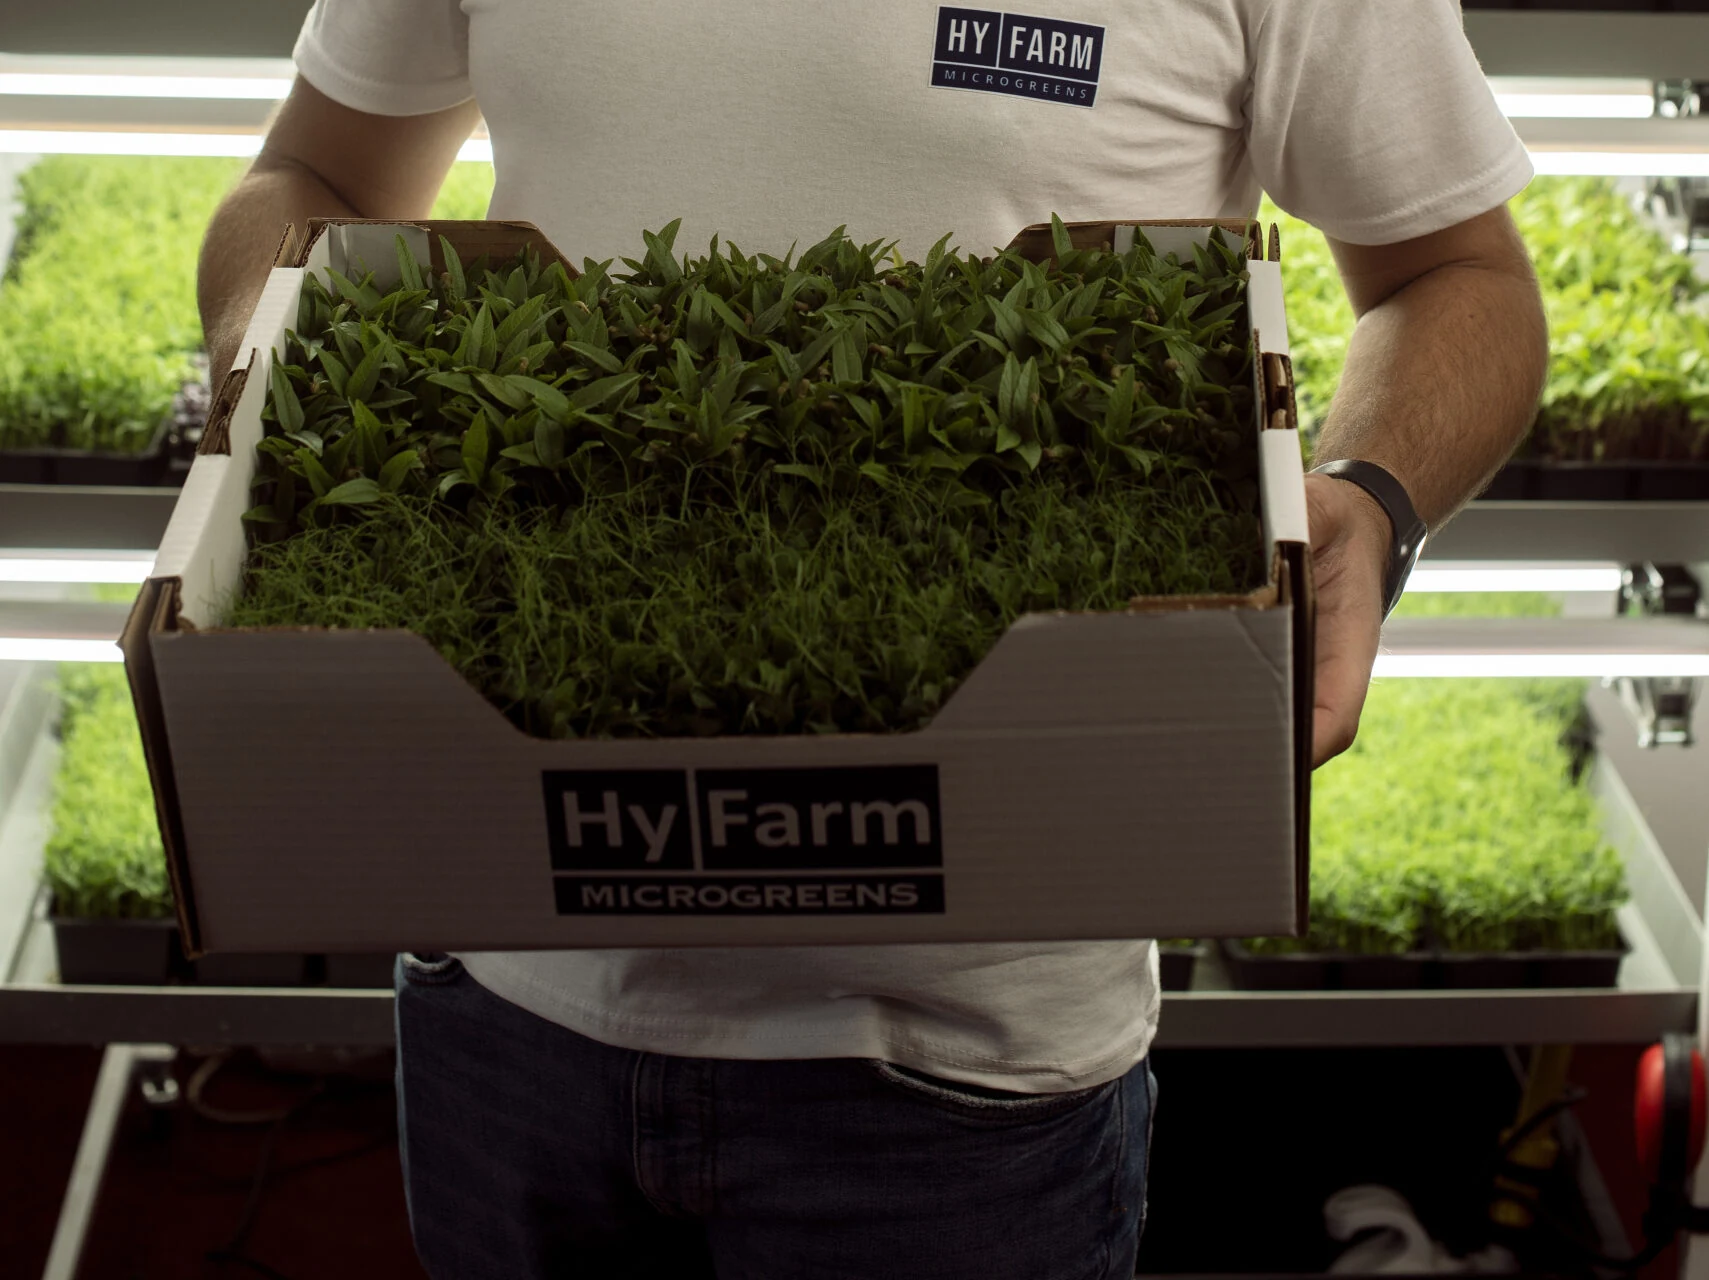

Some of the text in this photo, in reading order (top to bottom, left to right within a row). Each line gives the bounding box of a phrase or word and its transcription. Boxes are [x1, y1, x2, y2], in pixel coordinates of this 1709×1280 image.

[948, 19, 1094, 70] HY FARM
[944, 70, 1087, 99] MICROGREENS
[562, 790, 931, 862] Hy Farm
[581, 883, 919, 908] MICROGREENS
